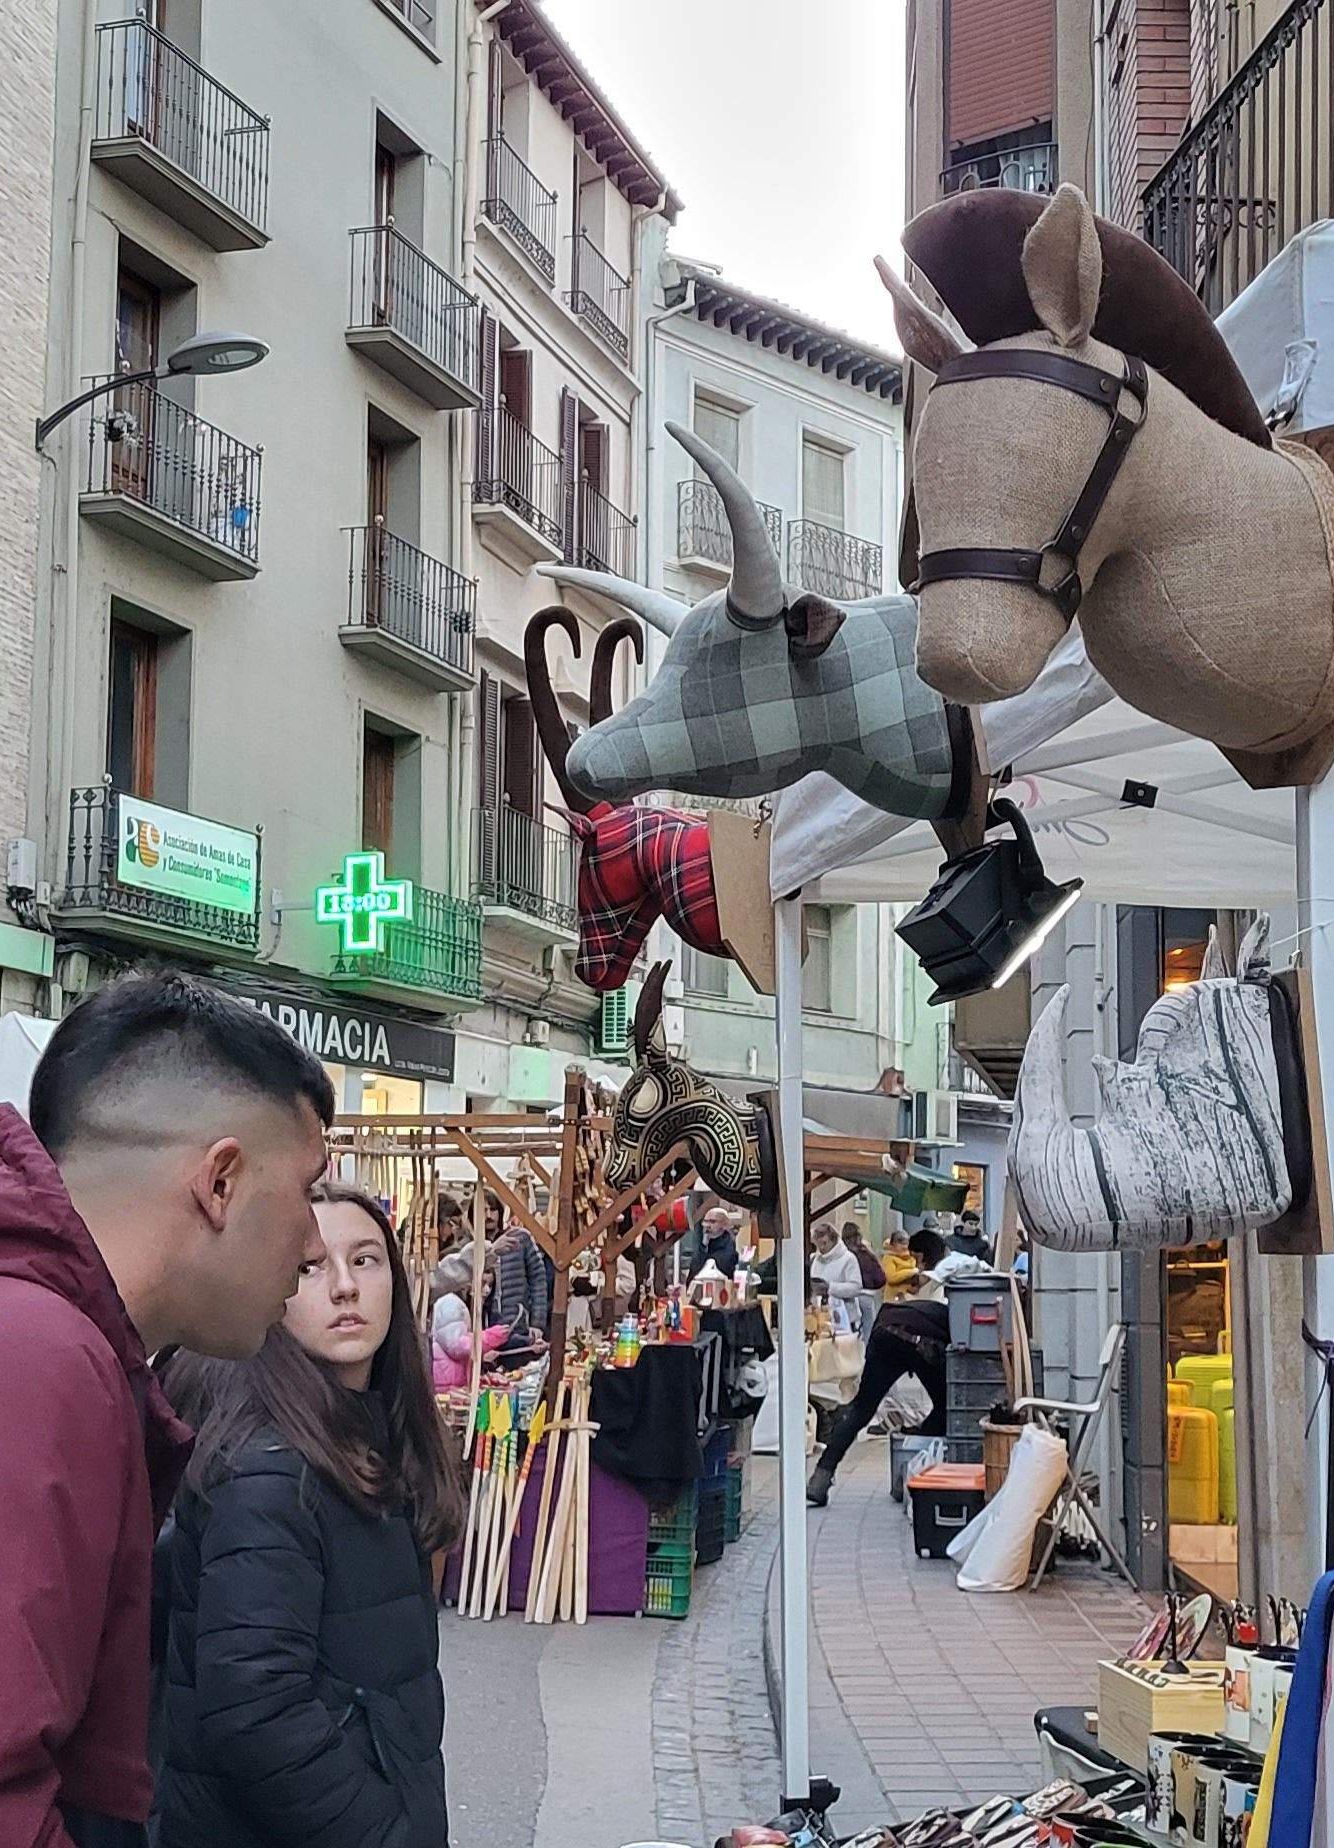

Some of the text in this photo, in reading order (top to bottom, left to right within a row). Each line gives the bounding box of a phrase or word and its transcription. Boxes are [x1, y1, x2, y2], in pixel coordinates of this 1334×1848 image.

[200, 842, 207, 857] de
[209, 844, 226, 862] Amas
[228, 850, 235, 865] de
[237, 853, 251, 870] Casa
[238, 996, 390, 1066] RMACIA
